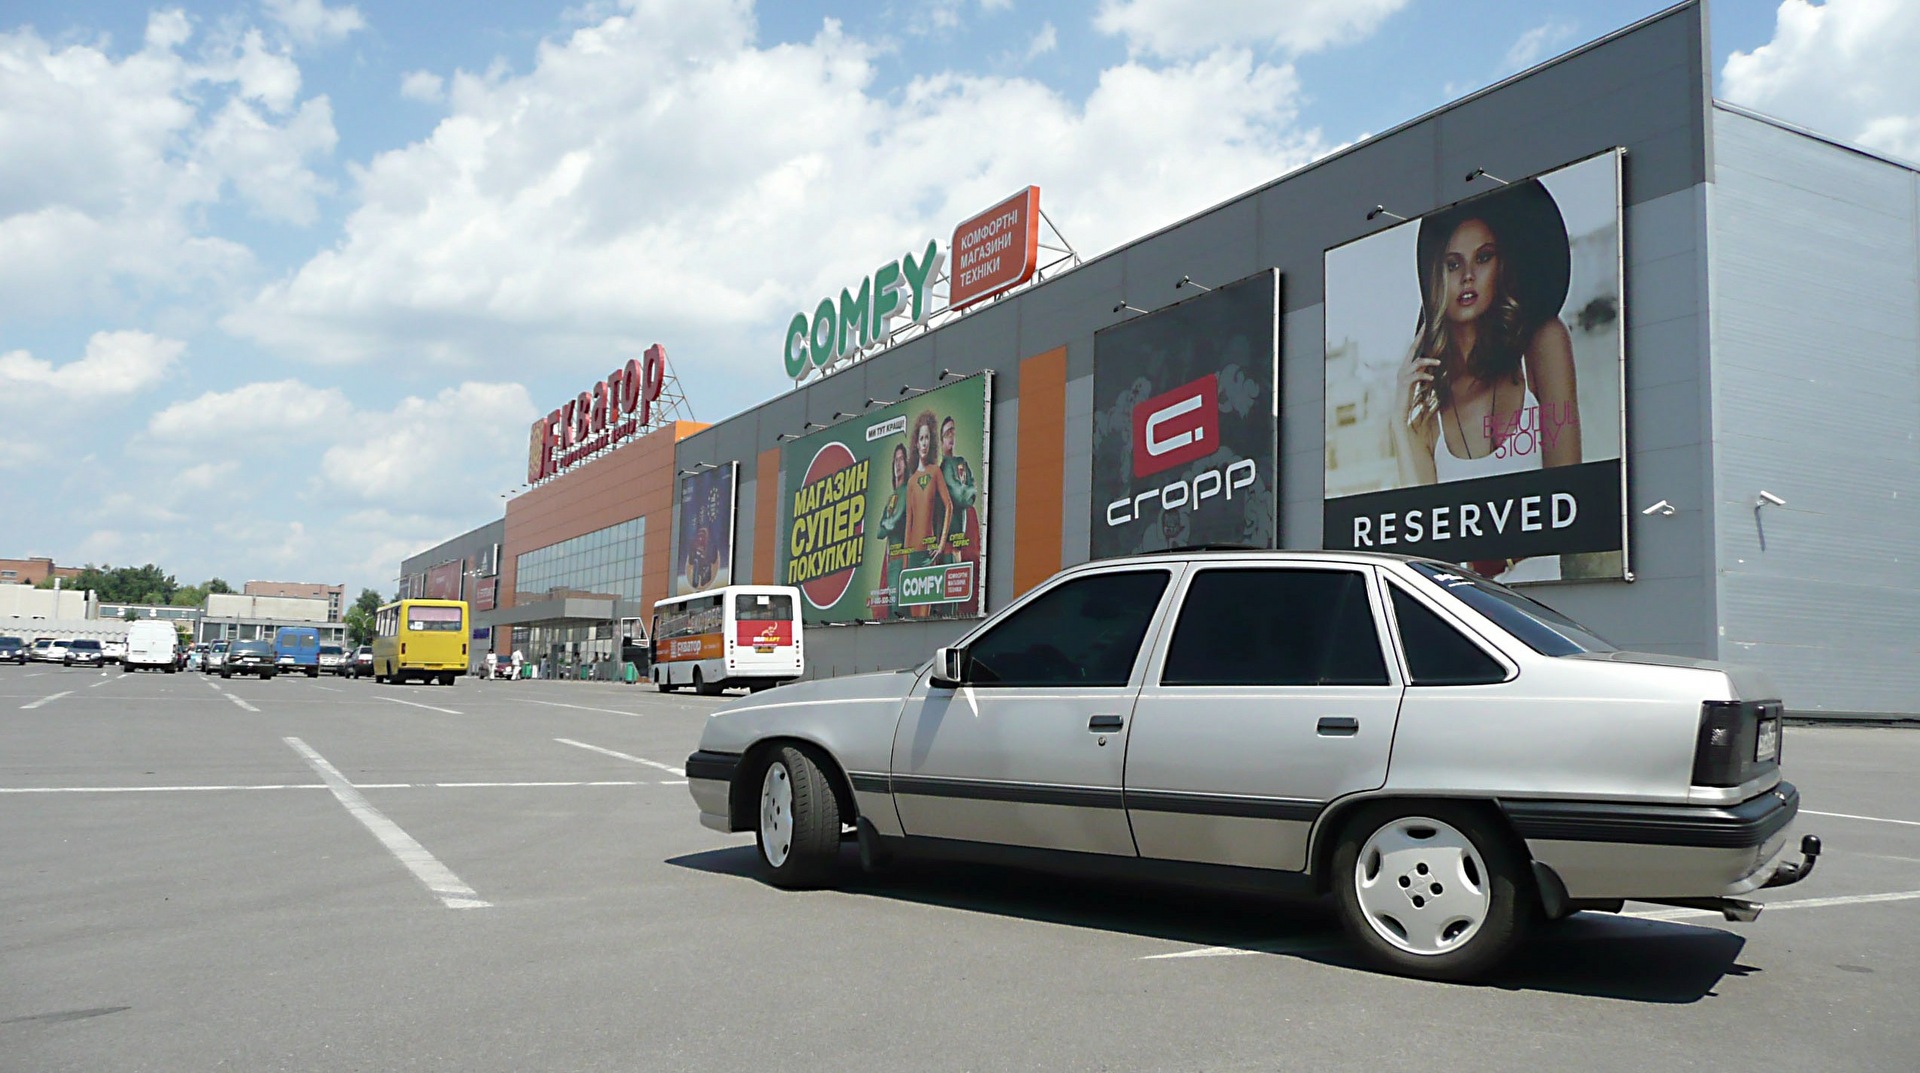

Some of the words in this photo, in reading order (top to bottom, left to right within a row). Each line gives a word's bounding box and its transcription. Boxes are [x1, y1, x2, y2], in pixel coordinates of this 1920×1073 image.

[960, 231, 1012, 270] МАГАЗИНИ
[961, 208, 1018, 250] КОМФОРТНІ
[960, 256, 1001, 288] ТЕХНІКИ
[784, 237, 946, 382] COMFY
[1483, 399, 1579, 439] BEAUTIFUL
[1495, 422, 1562, 460] STORY
[793, 459, 869, 519] МАГАЗИН
[1107, 458, 1256, 527] cropp
[791, 495, 867, 558] СУПЕР
[1354, 492, 1578, 548] RESERVED
[788, 537, 863, 584] ПОКУПКИ!
[902, 575, 943, 597] COMFY
